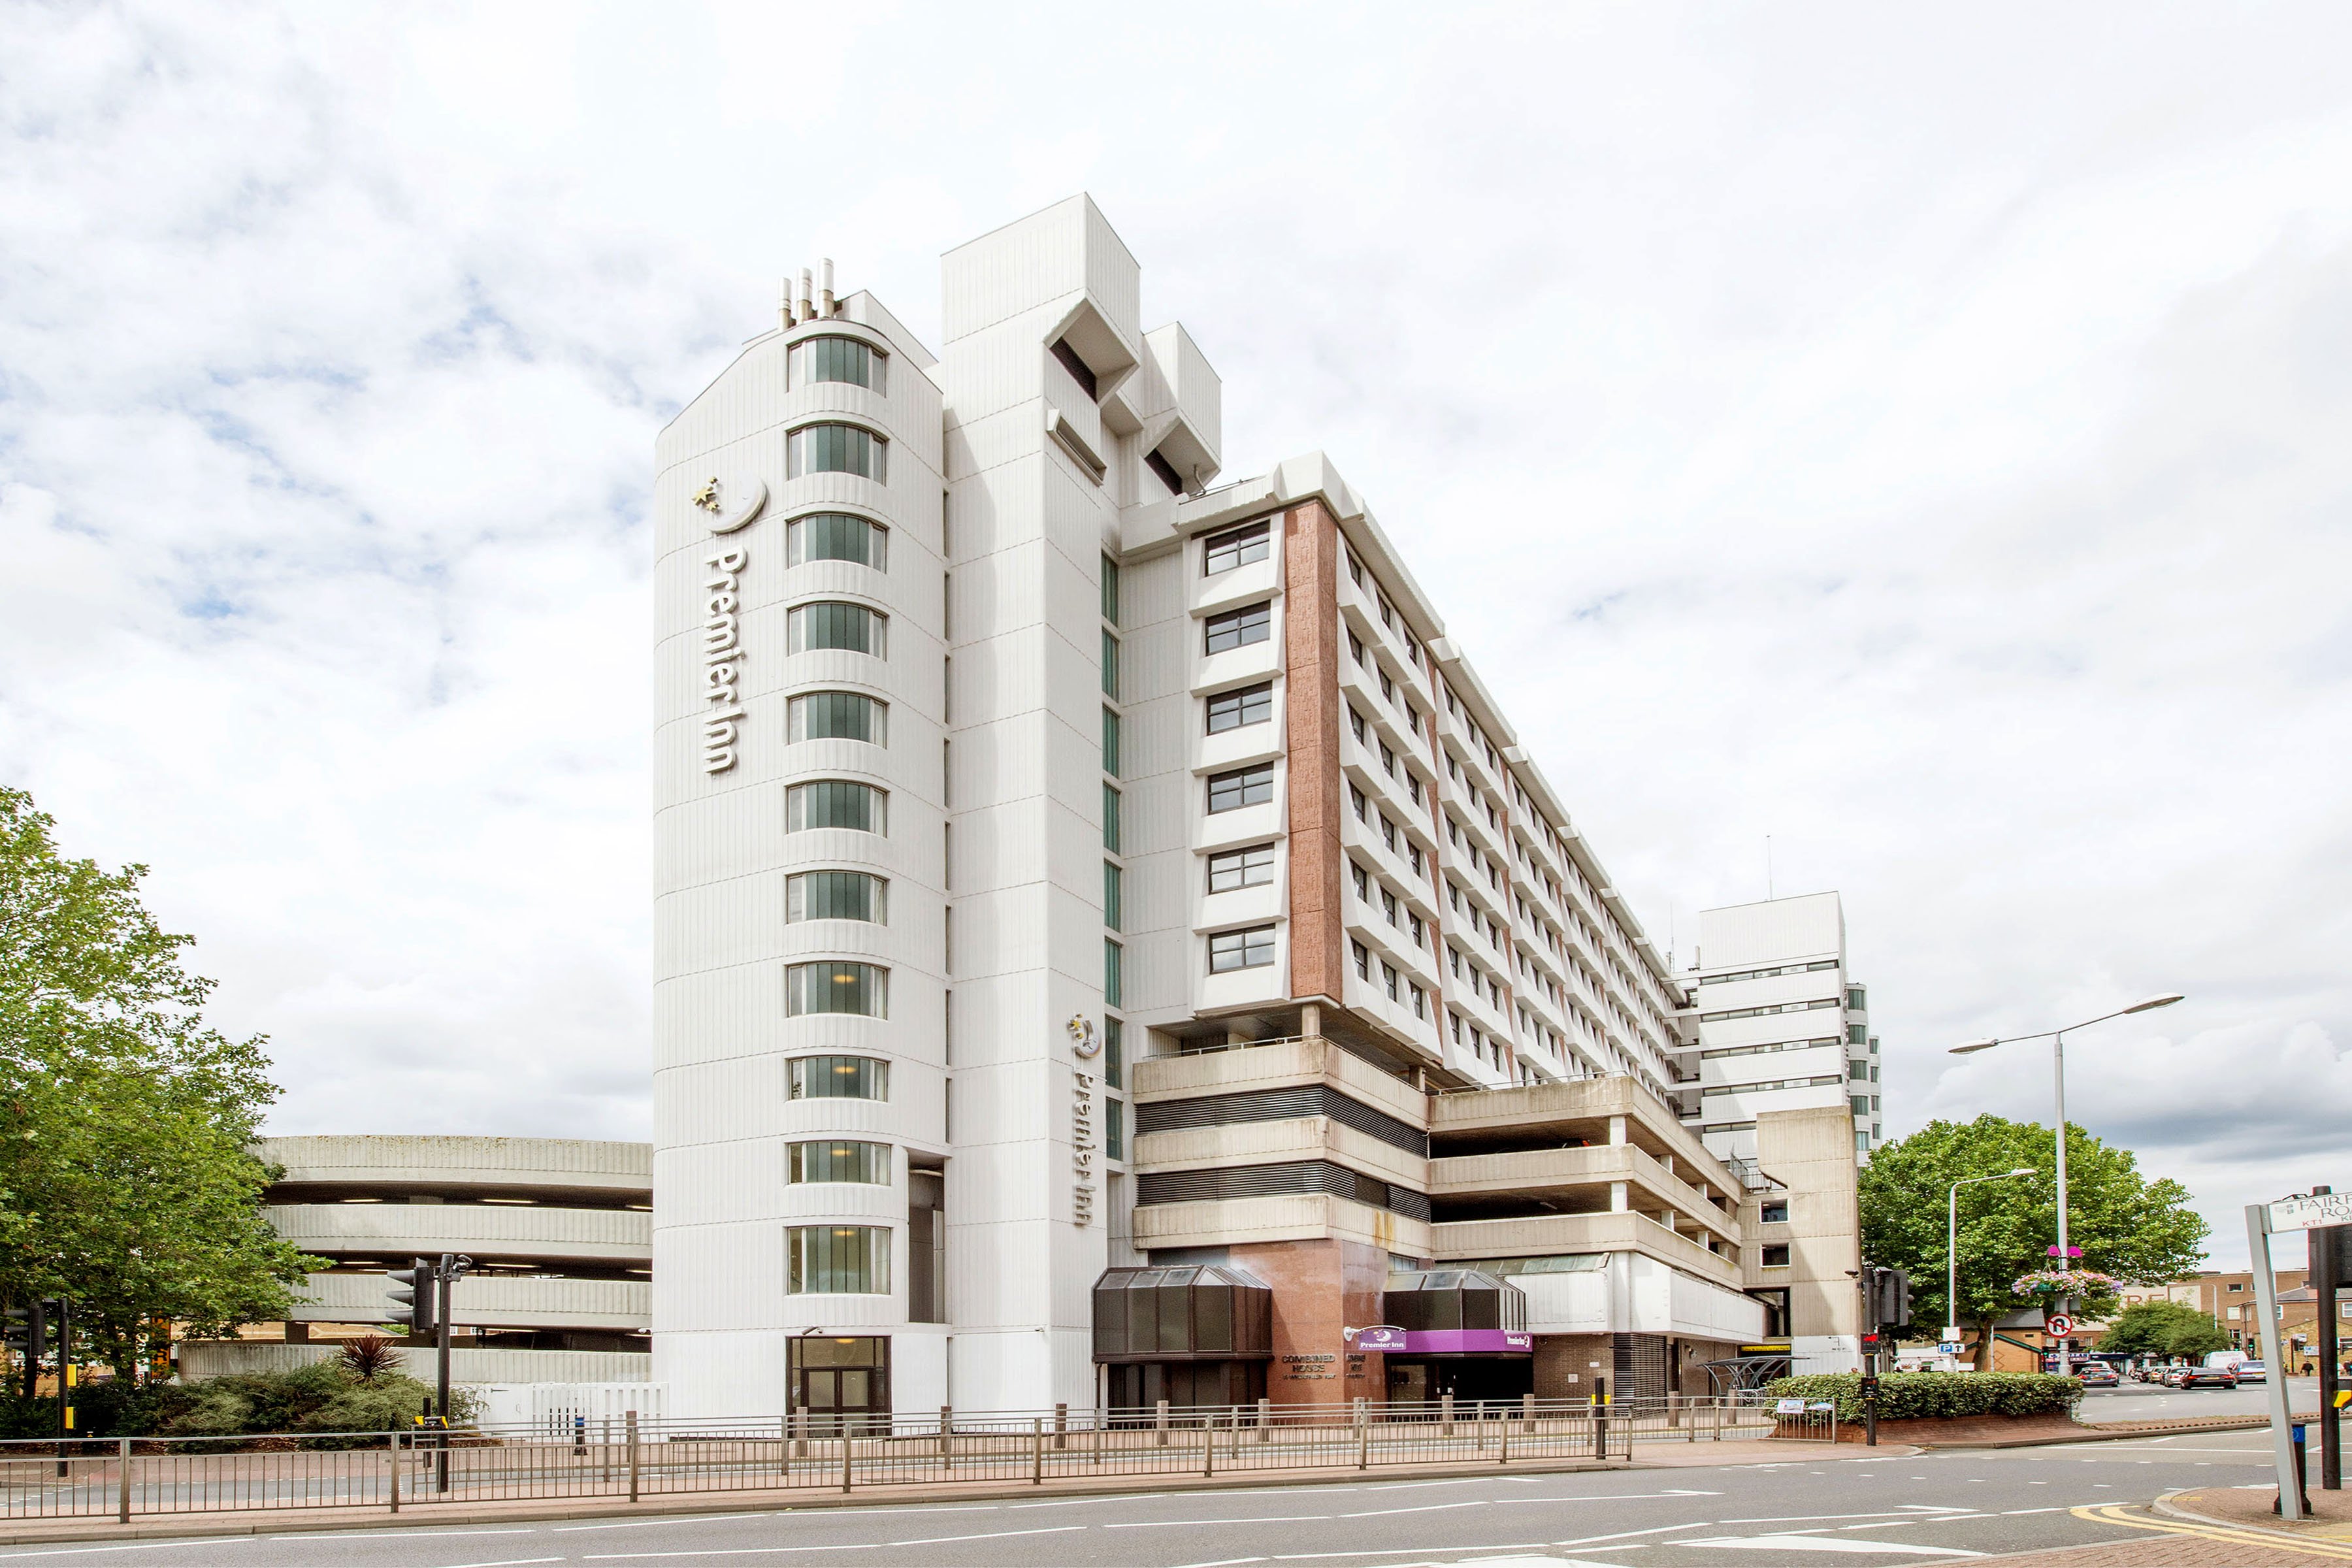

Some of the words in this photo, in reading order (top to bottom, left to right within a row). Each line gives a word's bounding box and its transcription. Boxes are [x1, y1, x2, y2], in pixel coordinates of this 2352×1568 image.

[704, 545, 746, 702] Premier
[704, 706, 746, 774] Inn
[1075, 1071, 1096, 1180] Premier
[1075, 1184, 1096, 1226] Inn
[2321, 1205, 2352, 1218] RO
[1292, 1364, 1326, 1373] HOUSE
